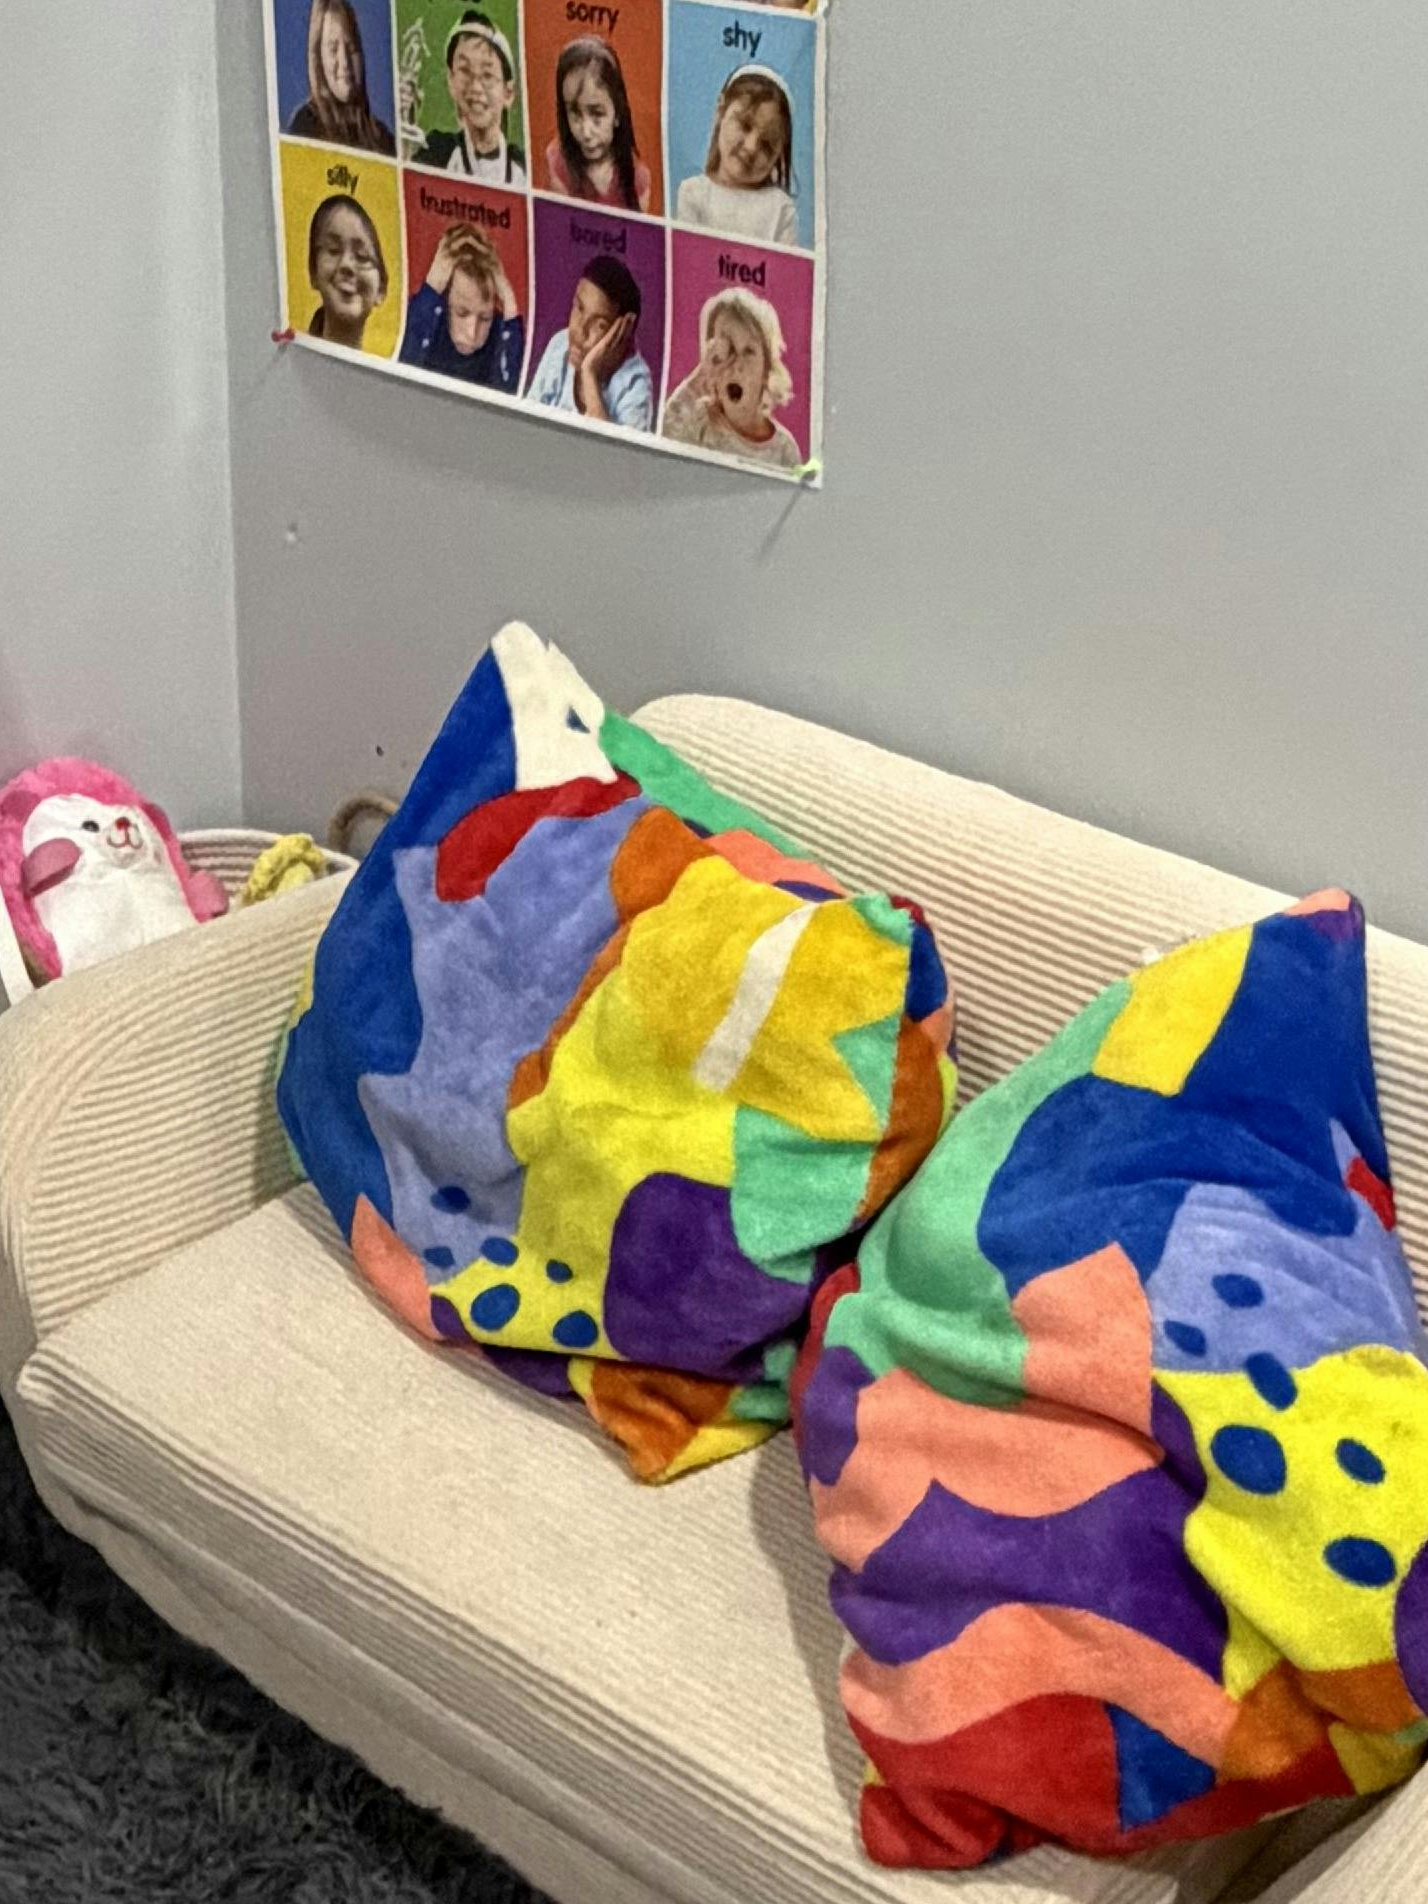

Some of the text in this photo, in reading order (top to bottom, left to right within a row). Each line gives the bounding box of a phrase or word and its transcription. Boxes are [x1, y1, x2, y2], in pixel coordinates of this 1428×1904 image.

[565, 0, 619, 32] sorry
[722, 21, 762, 57] shy
[326, 164, 360, 196] silly
[419, 186, 511, 229] frustrated
[570, 216, 627, 254] bored
[717, 252, 767, 286] tired
